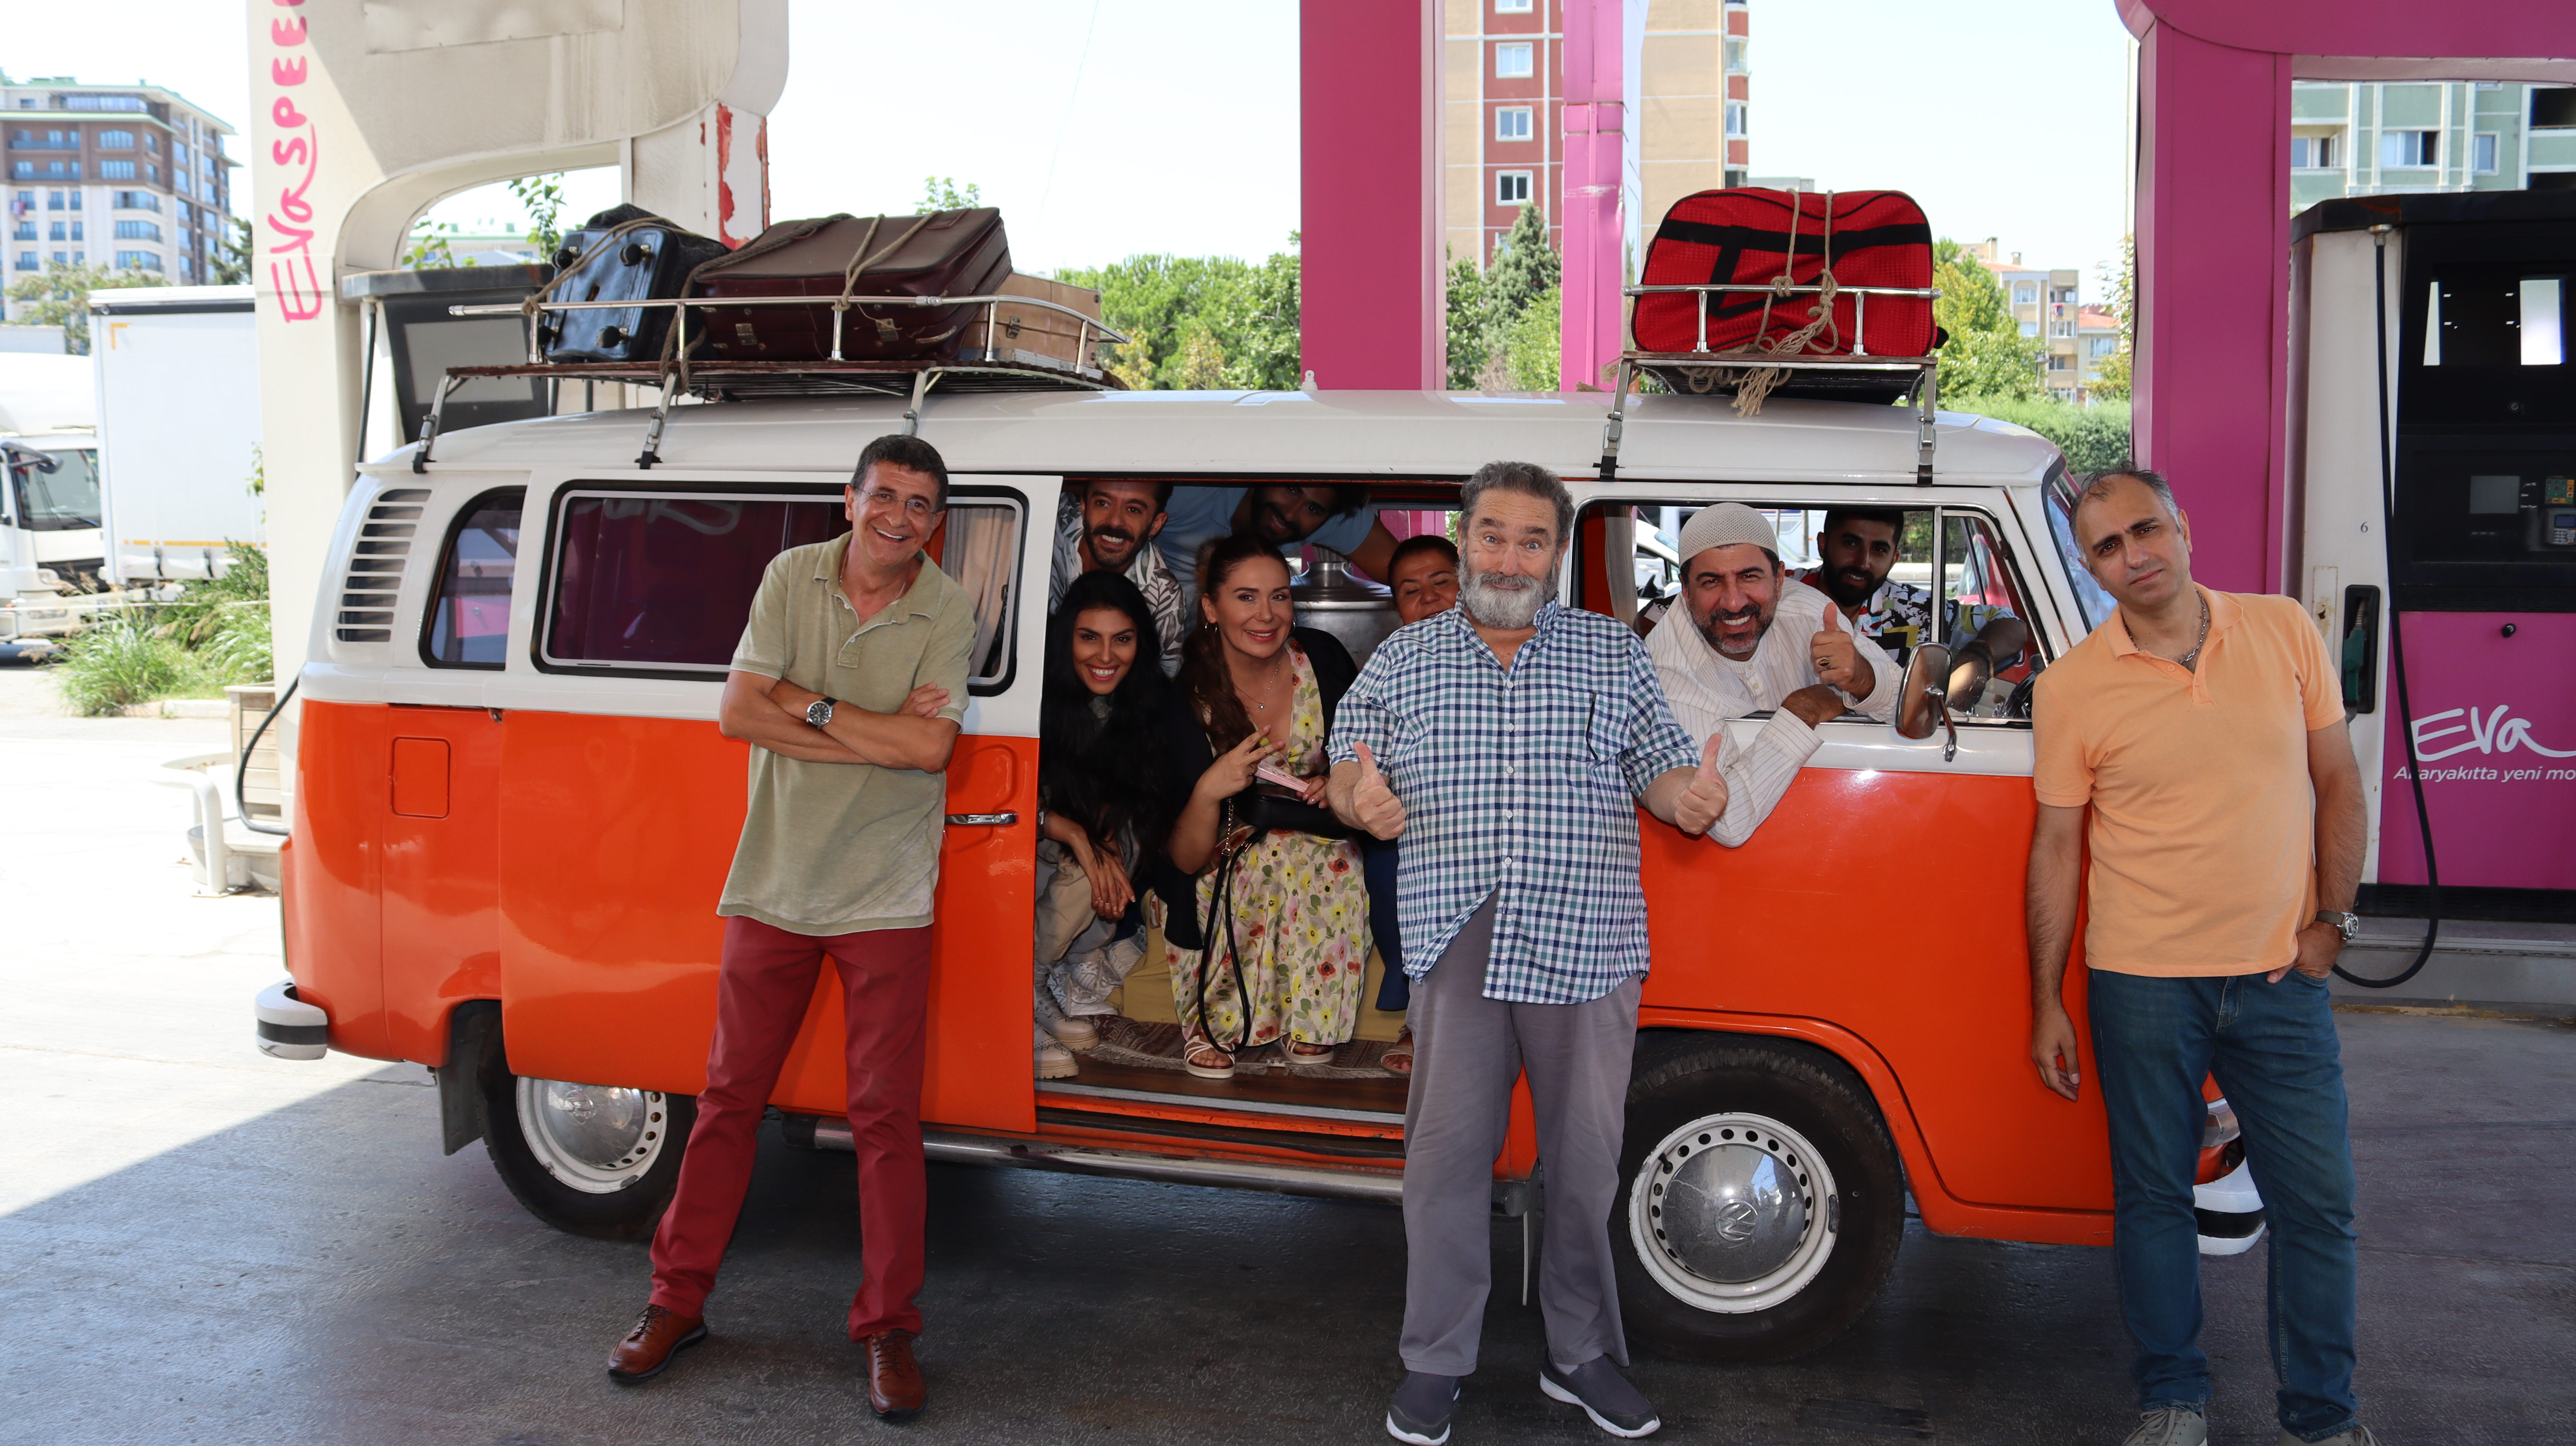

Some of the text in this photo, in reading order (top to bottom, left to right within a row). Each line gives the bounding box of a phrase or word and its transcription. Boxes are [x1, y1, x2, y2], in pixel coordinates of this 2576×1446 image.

[272, 0, 307, 166] SPEE
[2360, 520, 2369, 533] 6
[2393, 766, 2497, 783] Aaryakıtta
[2501, 766, 2544, 783] yeni
